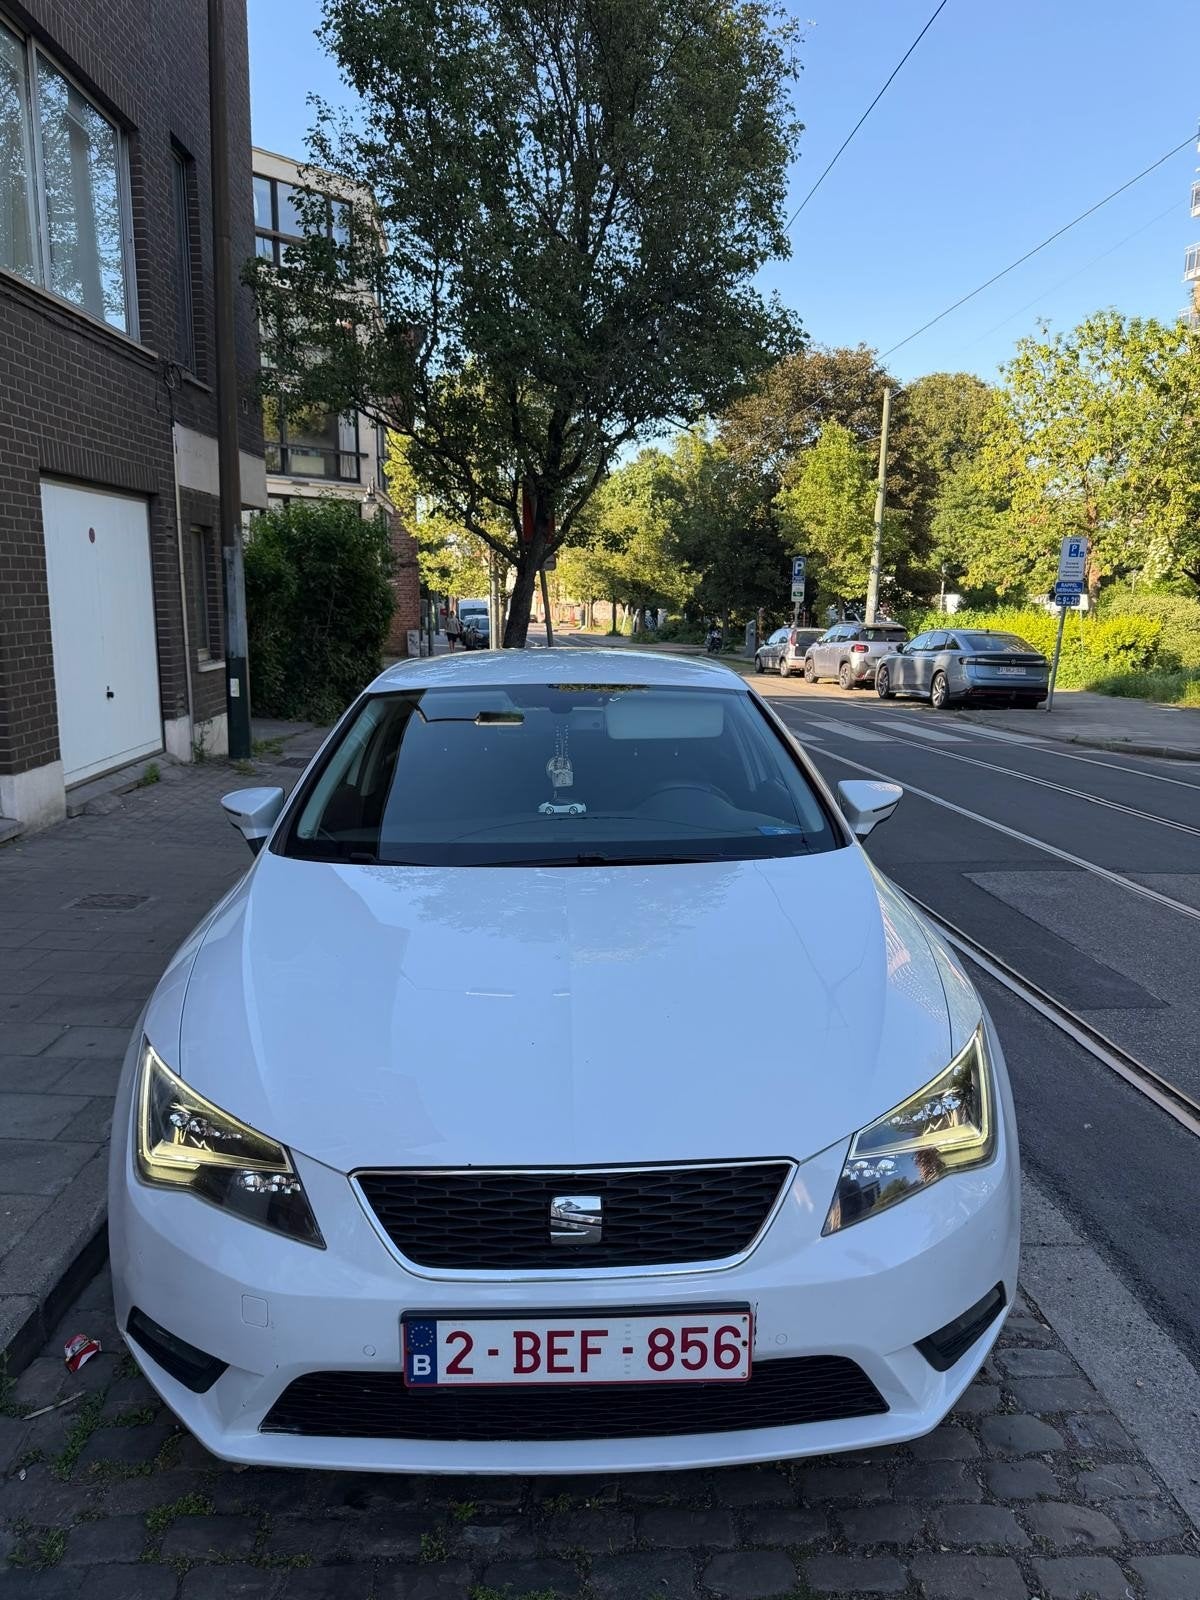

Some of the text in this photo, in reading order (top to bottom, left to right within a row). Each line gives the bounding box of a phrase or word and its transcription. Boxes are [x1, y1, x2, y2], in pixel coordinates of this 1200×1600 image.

[795, 561, 804, 574] P
[412, 1325, 742, 1376] B 2-BEF-856
